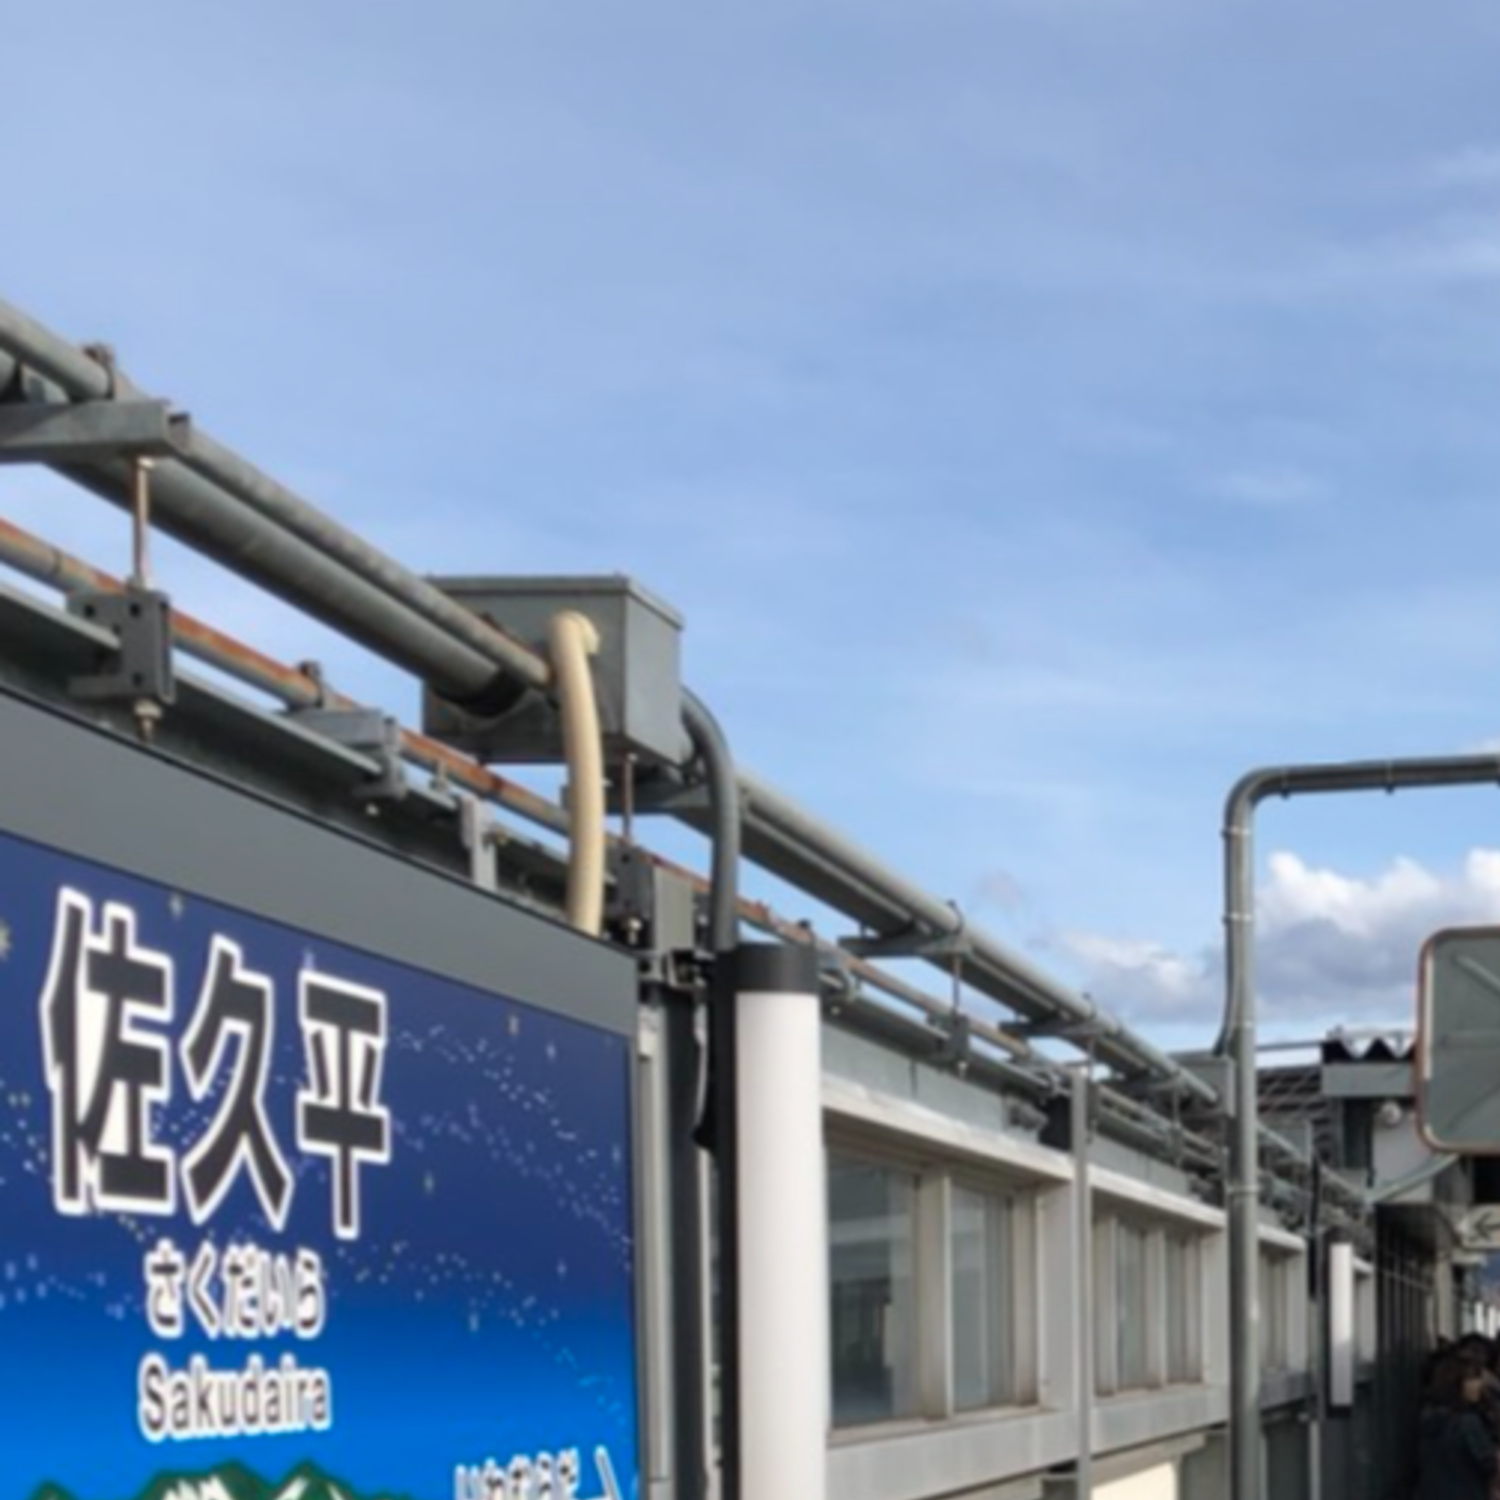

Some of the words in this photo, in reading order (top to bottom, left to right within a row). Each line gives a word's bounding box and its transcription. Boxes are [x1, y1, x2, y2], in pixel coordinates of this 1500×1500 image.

[43, 888, 389, 1237] 佐久平
[146, 1241, 324, 1337] さくだいら
[140, 1355, 330, 1441] Sakudaira
